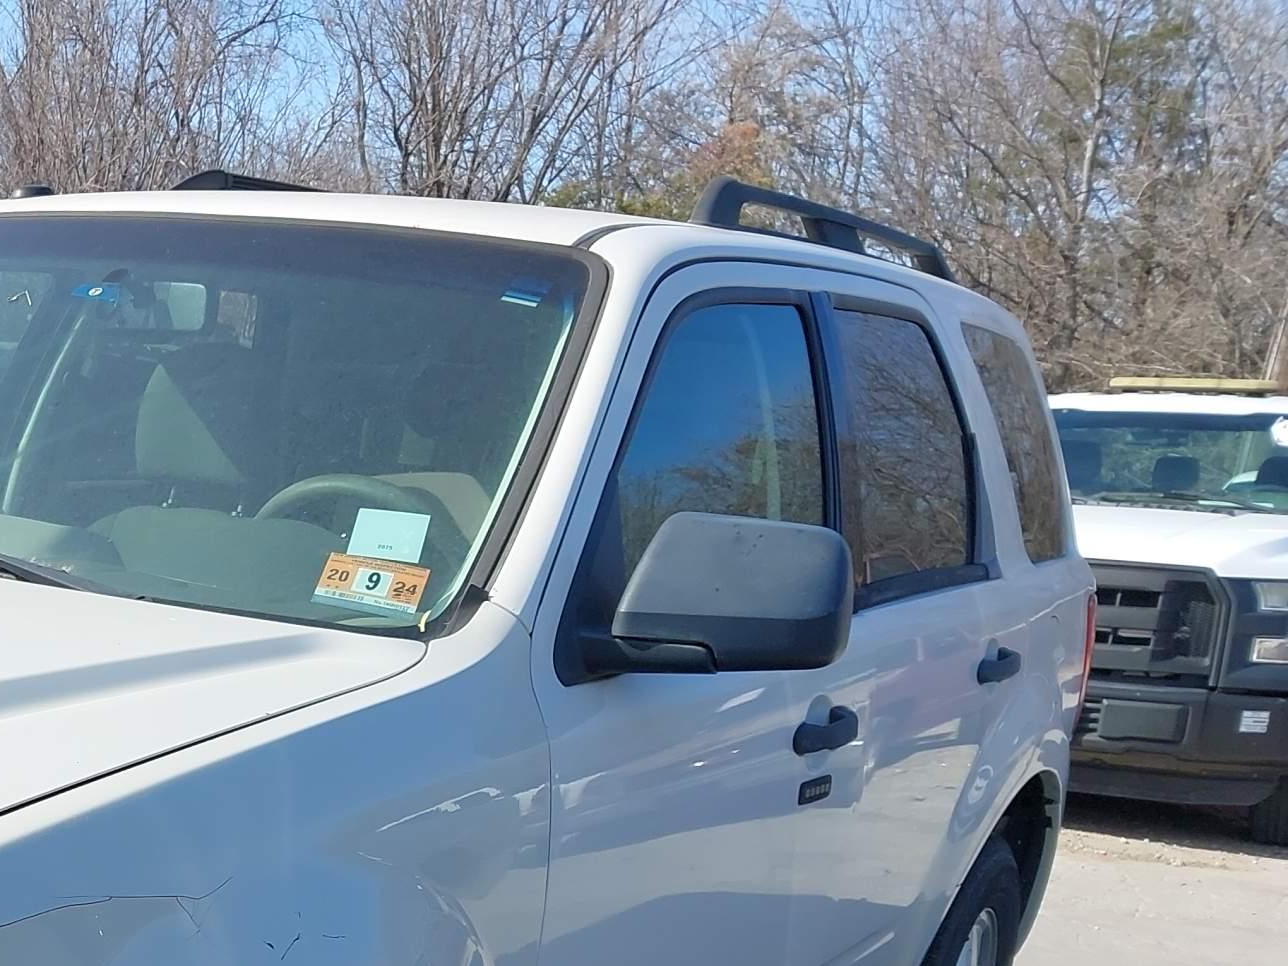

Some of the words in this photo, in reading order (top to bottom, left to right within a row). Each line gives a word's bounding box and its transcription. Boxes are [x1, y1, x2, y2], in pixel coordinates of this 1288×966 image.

[326, 568, 350, 582] 20
[365, 572, 381, 591] 9
[392, 581, 418, 596] 24
